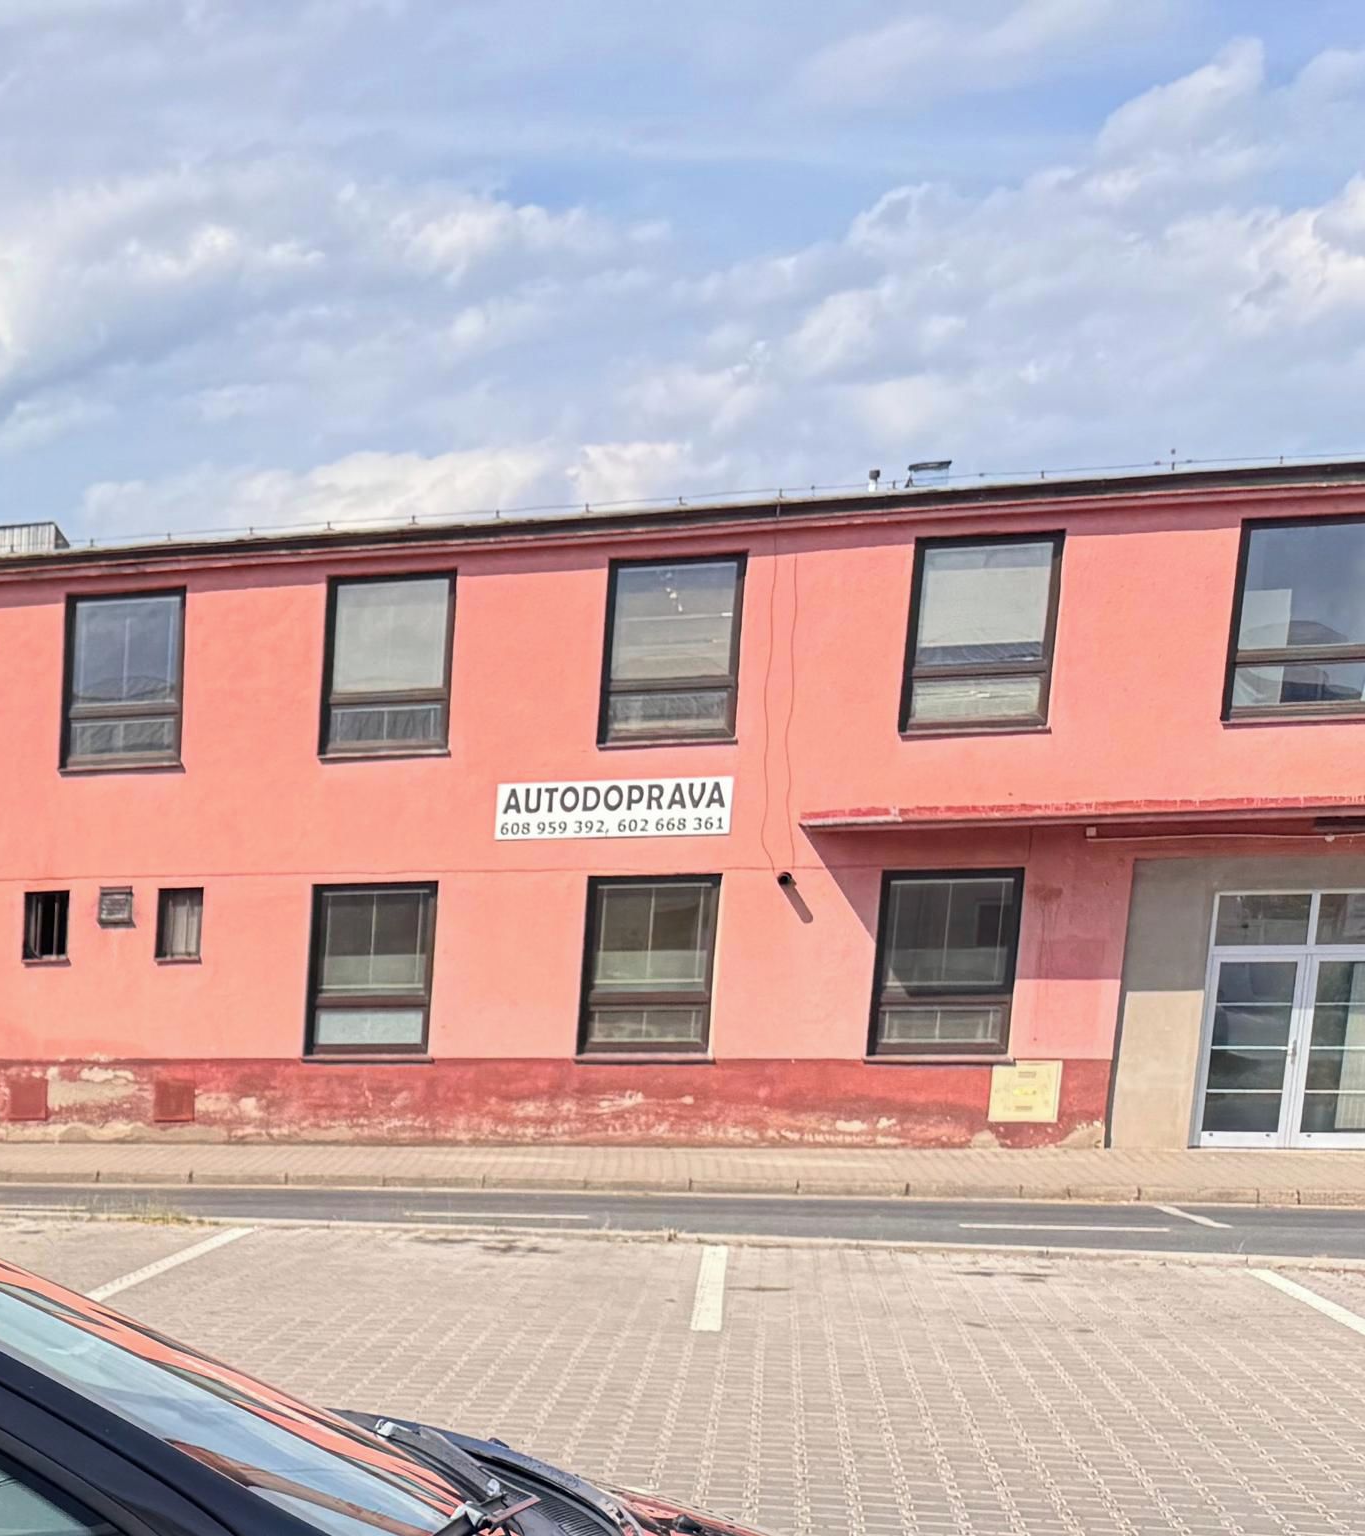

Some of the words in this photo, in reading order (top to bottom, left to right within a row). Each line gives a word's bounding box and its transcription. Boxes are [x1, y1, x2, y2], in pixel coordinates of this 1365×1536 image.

[502, 781, 726, 815] AUTODOPRAVA
[500, 821, 531, 836] 608
[537, 820, 567, 834] 959
[573, 820, 609, 834] 392,
[617, 818, 649, 832] 602
[655, 817, 687, 831] 668
[693, 816, 724, 830] 361
